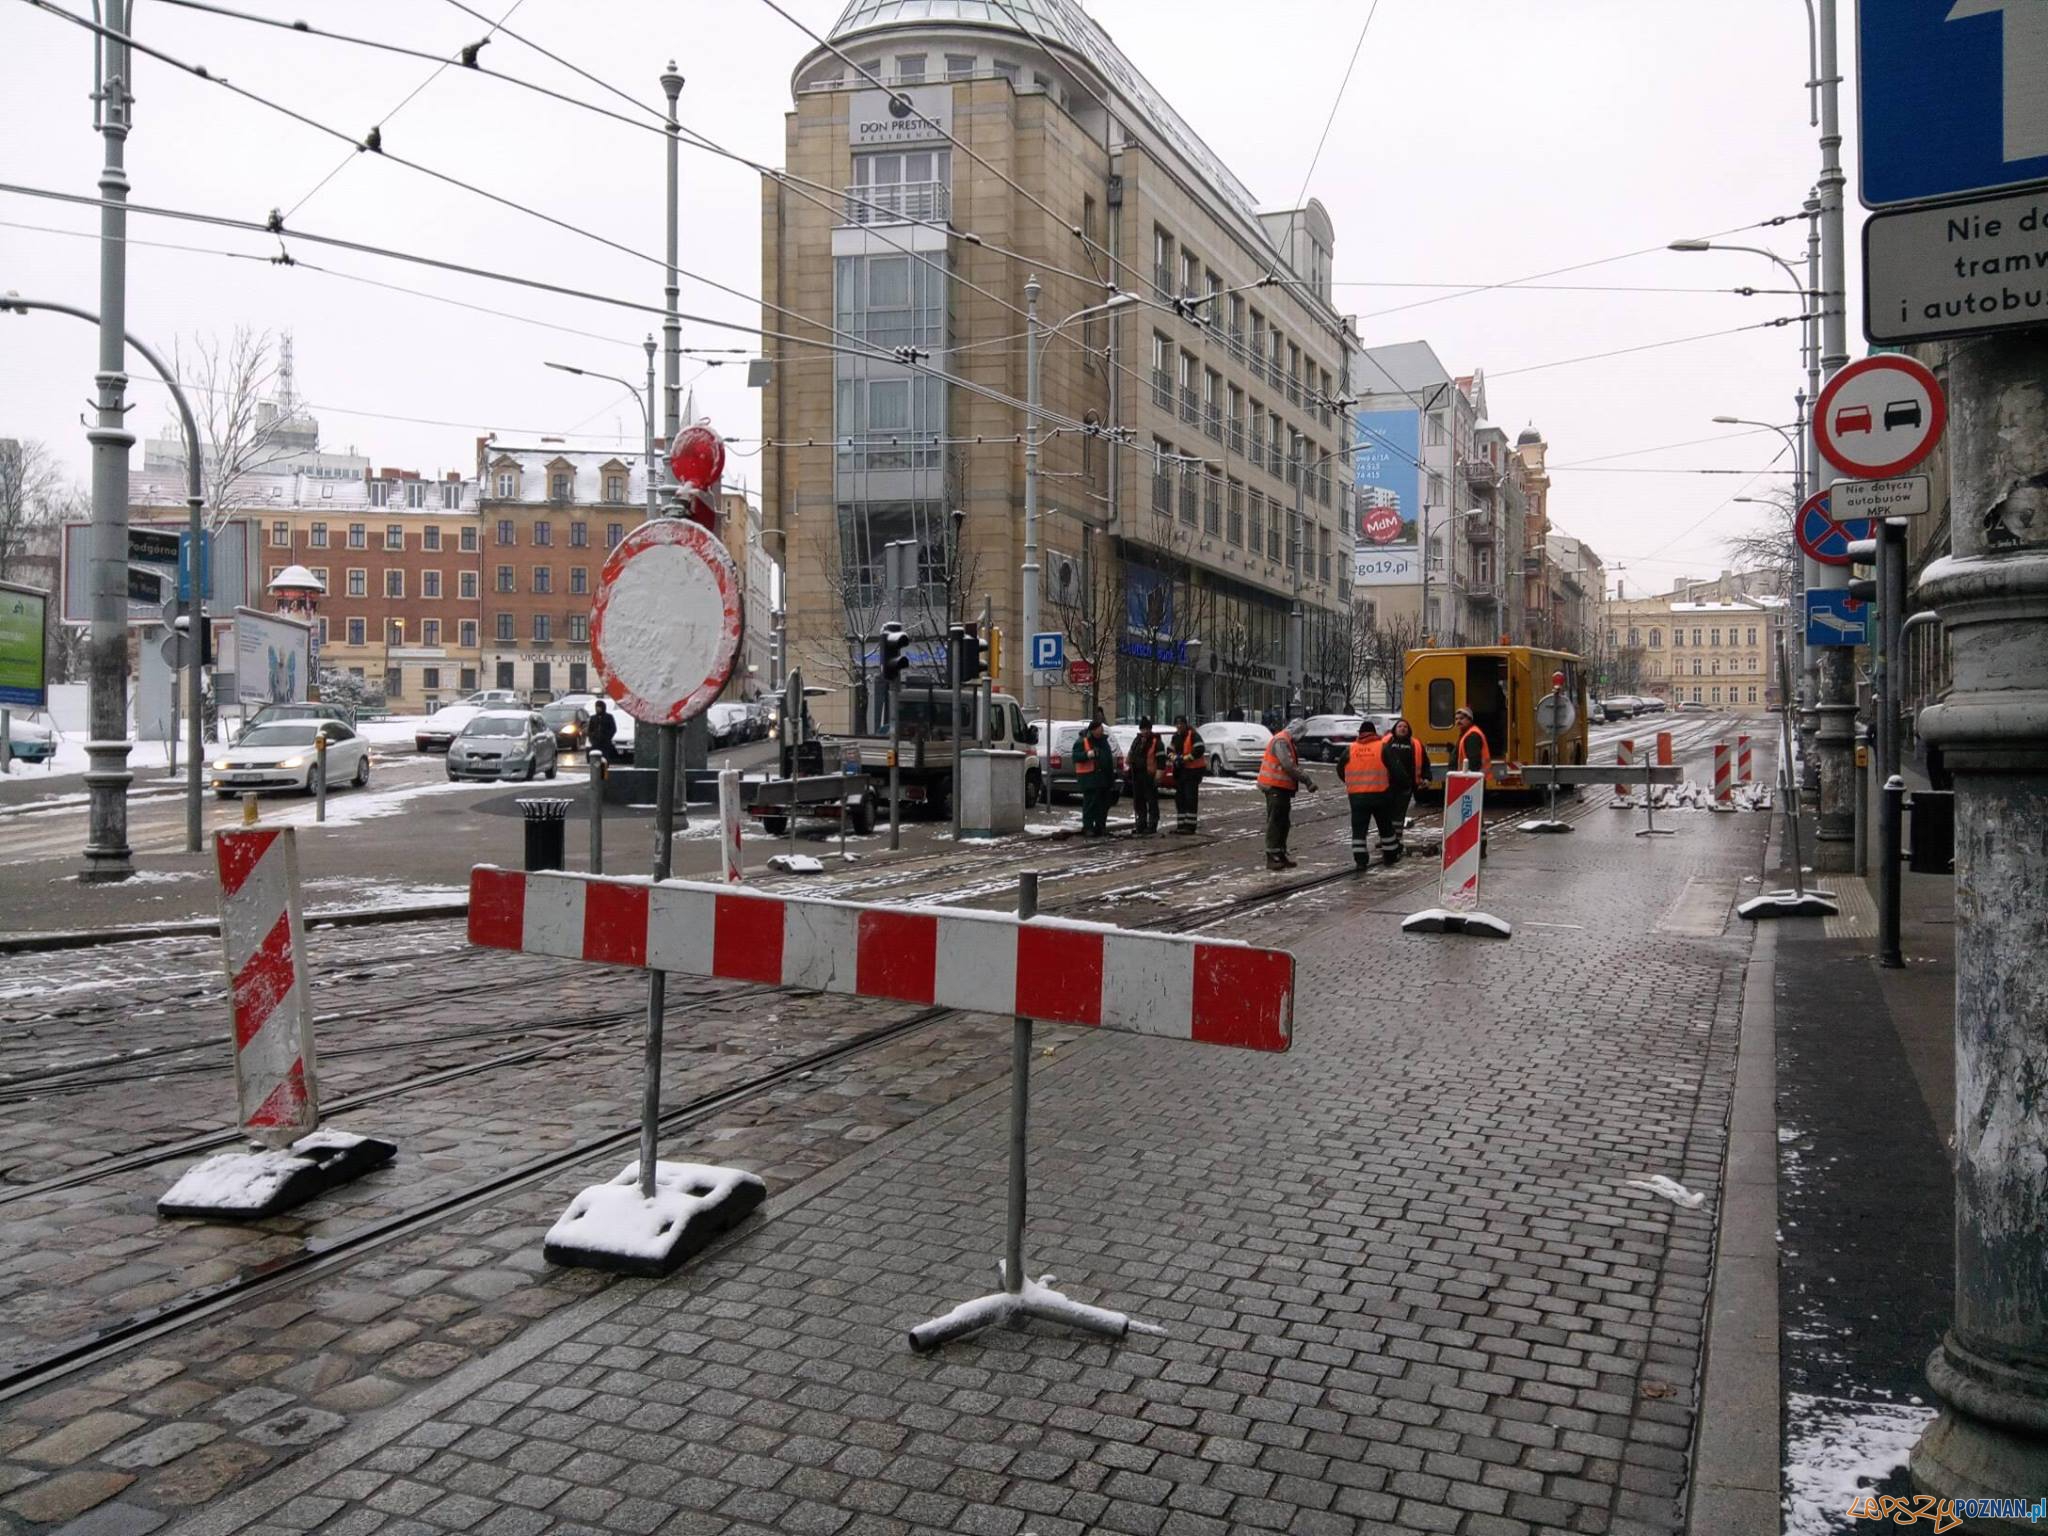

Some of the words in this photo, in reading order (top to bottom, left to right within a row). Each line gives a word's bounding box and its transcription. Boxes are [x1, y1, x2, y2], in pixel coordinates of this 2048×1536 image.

[860, 122, 887, 133] DON
[892, 118, 942, 131] PRESTIGE
[1948, 215, 2001, 242] Nie
[1901, 299, 1907, 323] i
[1846, 485, 1865, 494] Nie
[1871, 481, 1914, 492] dotyczy
[1867, 506, 1892, 516] MPK
[1367, 516, 1398, 533] MdM
[1355, 560, 1408, 576] go19.pl
